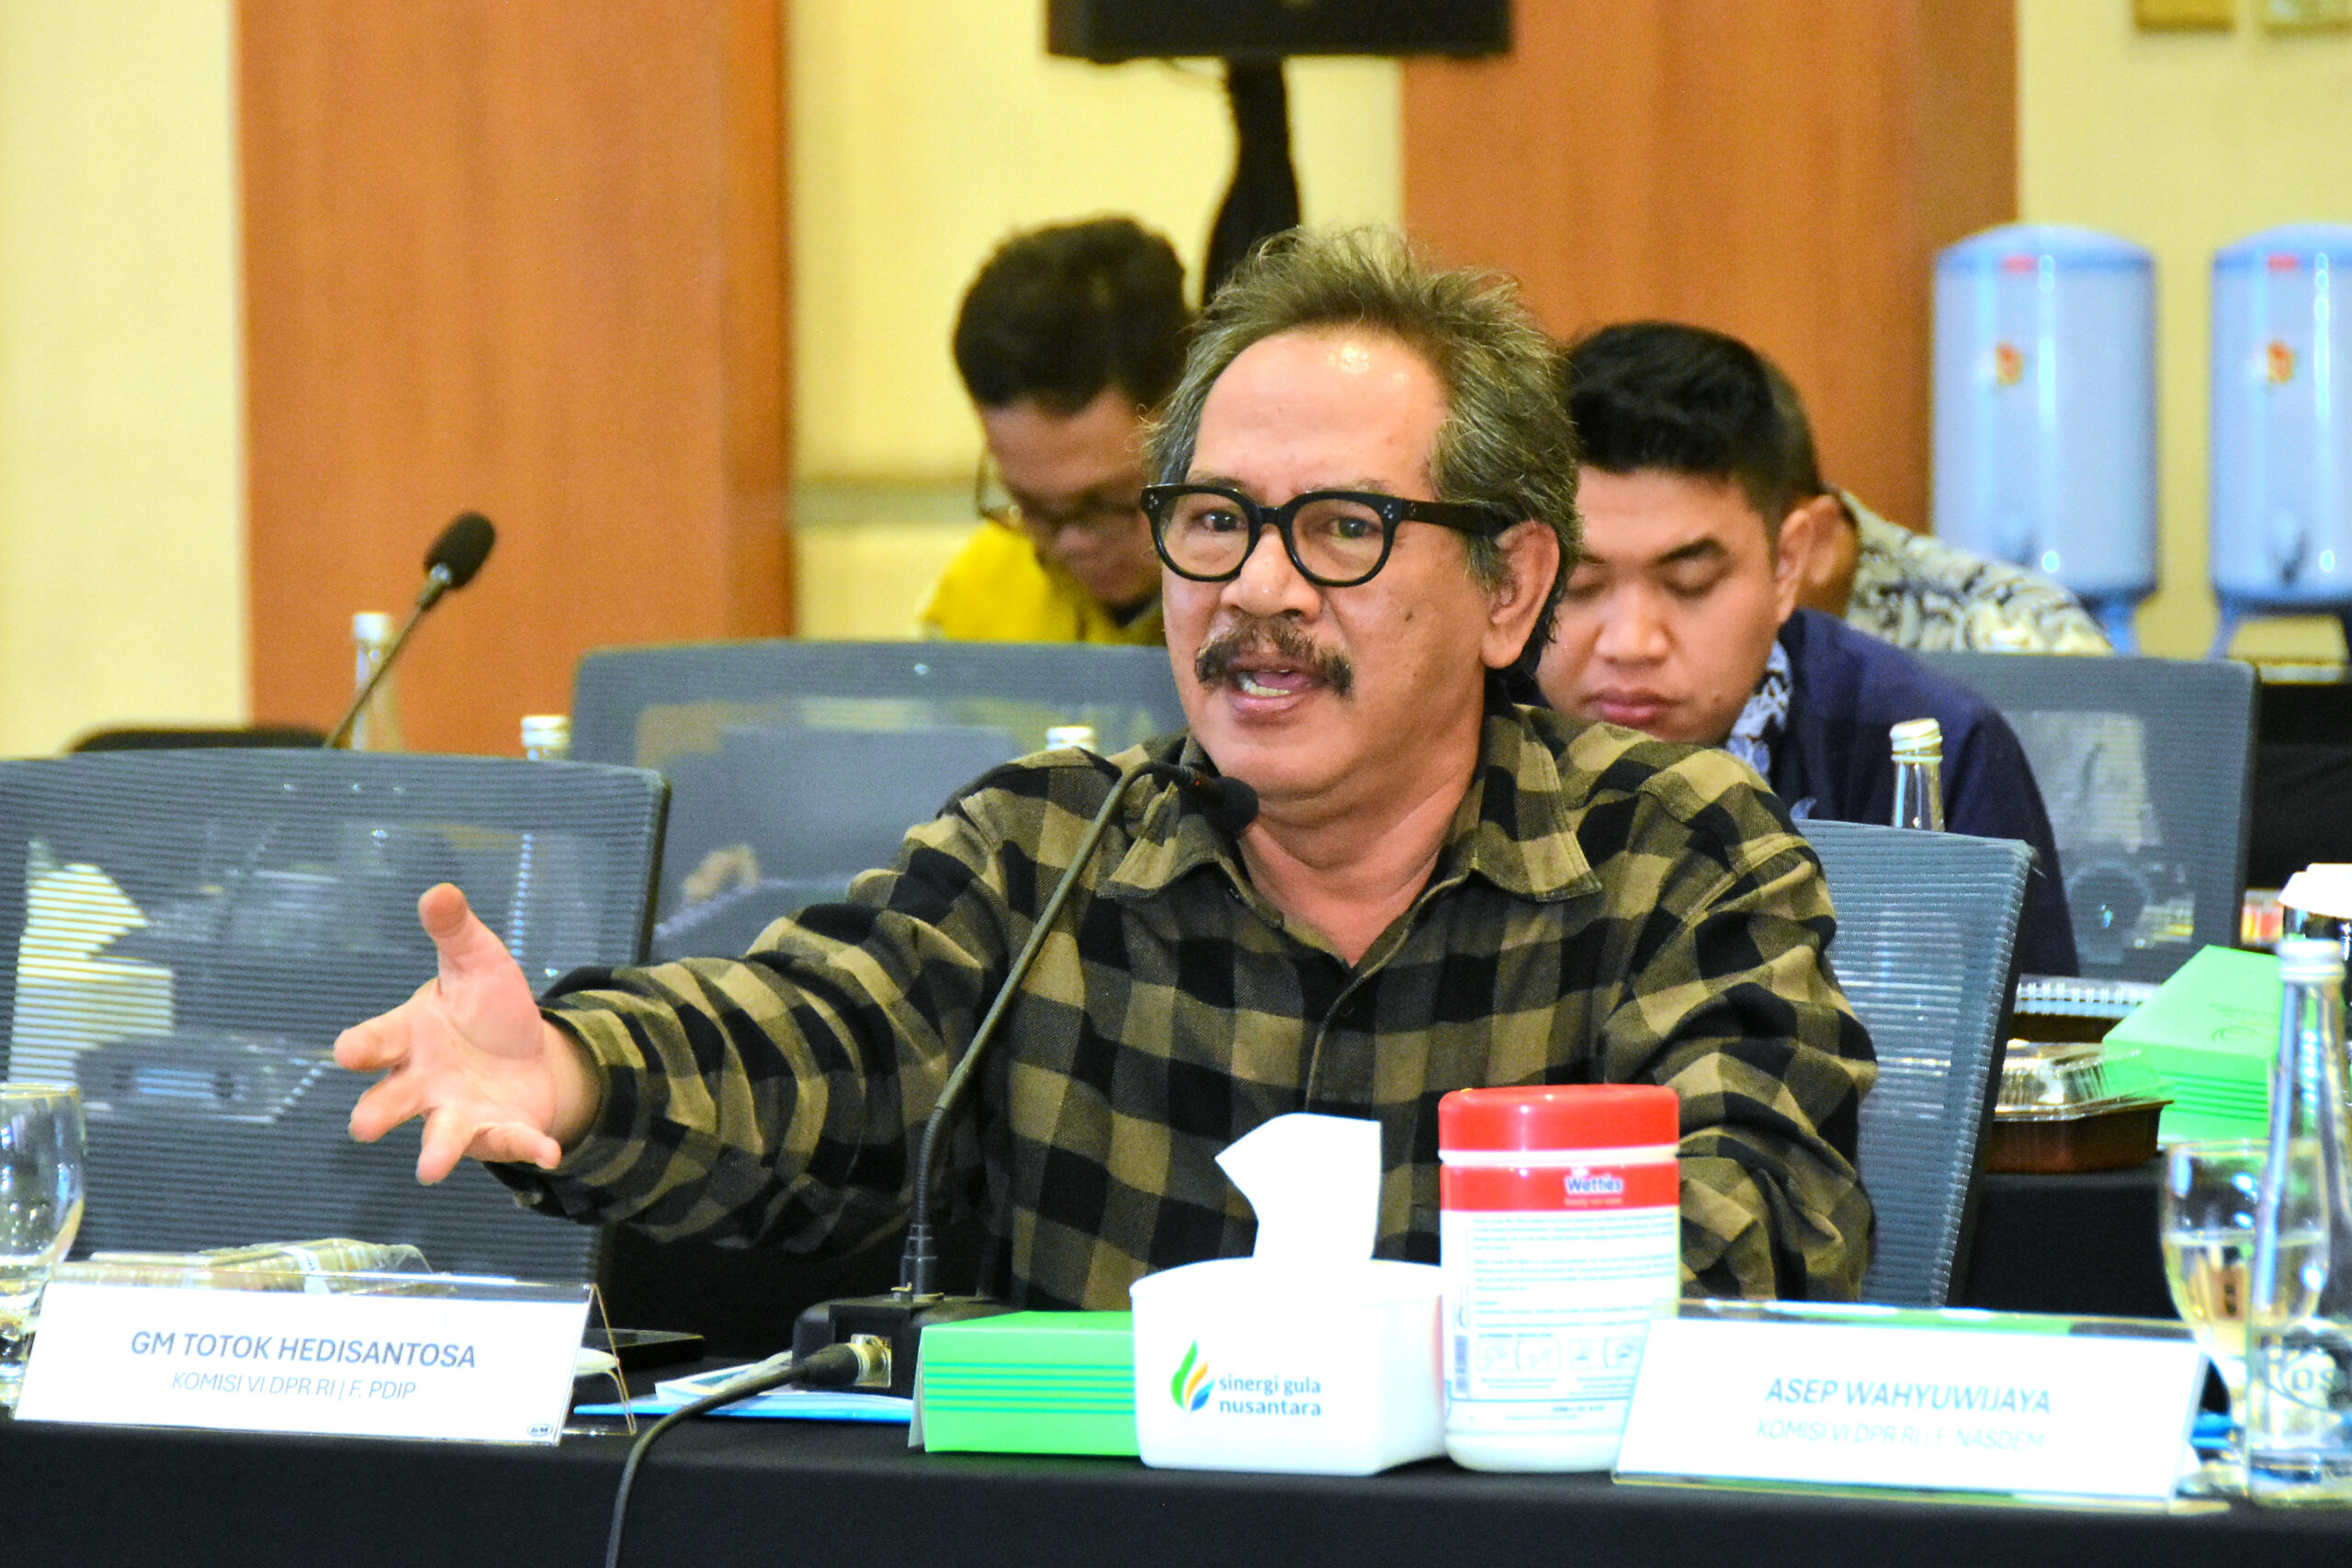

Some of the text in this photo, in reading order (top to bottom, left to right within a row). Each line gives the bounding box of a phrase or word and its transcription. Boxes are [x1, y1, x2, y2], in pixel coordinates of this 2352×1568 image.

[130, 1330, 476, 1369] GM TOTOK HEDISANTOSA
[172, 1371, 243, 1393] KOMISI
[248, 1375, 266, 1393] VI
[269, 1376, 311, 1395] DPR
[315, 1378, 336, 1396] RI
[349, 1380, 364, 1398] F.
[368, 1381, 417, 1399] PDIP
[1218, 1373, 1321, 1396] sinergi gula
[1764, 1377, 2052, 1415] ASEP WAHYUWIJAYA
[1219, 1399, 1322, 1416] nusantara
[1756, 1419, 1826, 1441] KOMISI
[1831, 1424, 1850, 1441] VI
[1853, 1424, 1897, 1444] DPR
[1901, 1426, 1921, 1446] RI
[1954, 1428, 2045, 1451] NASDEM
